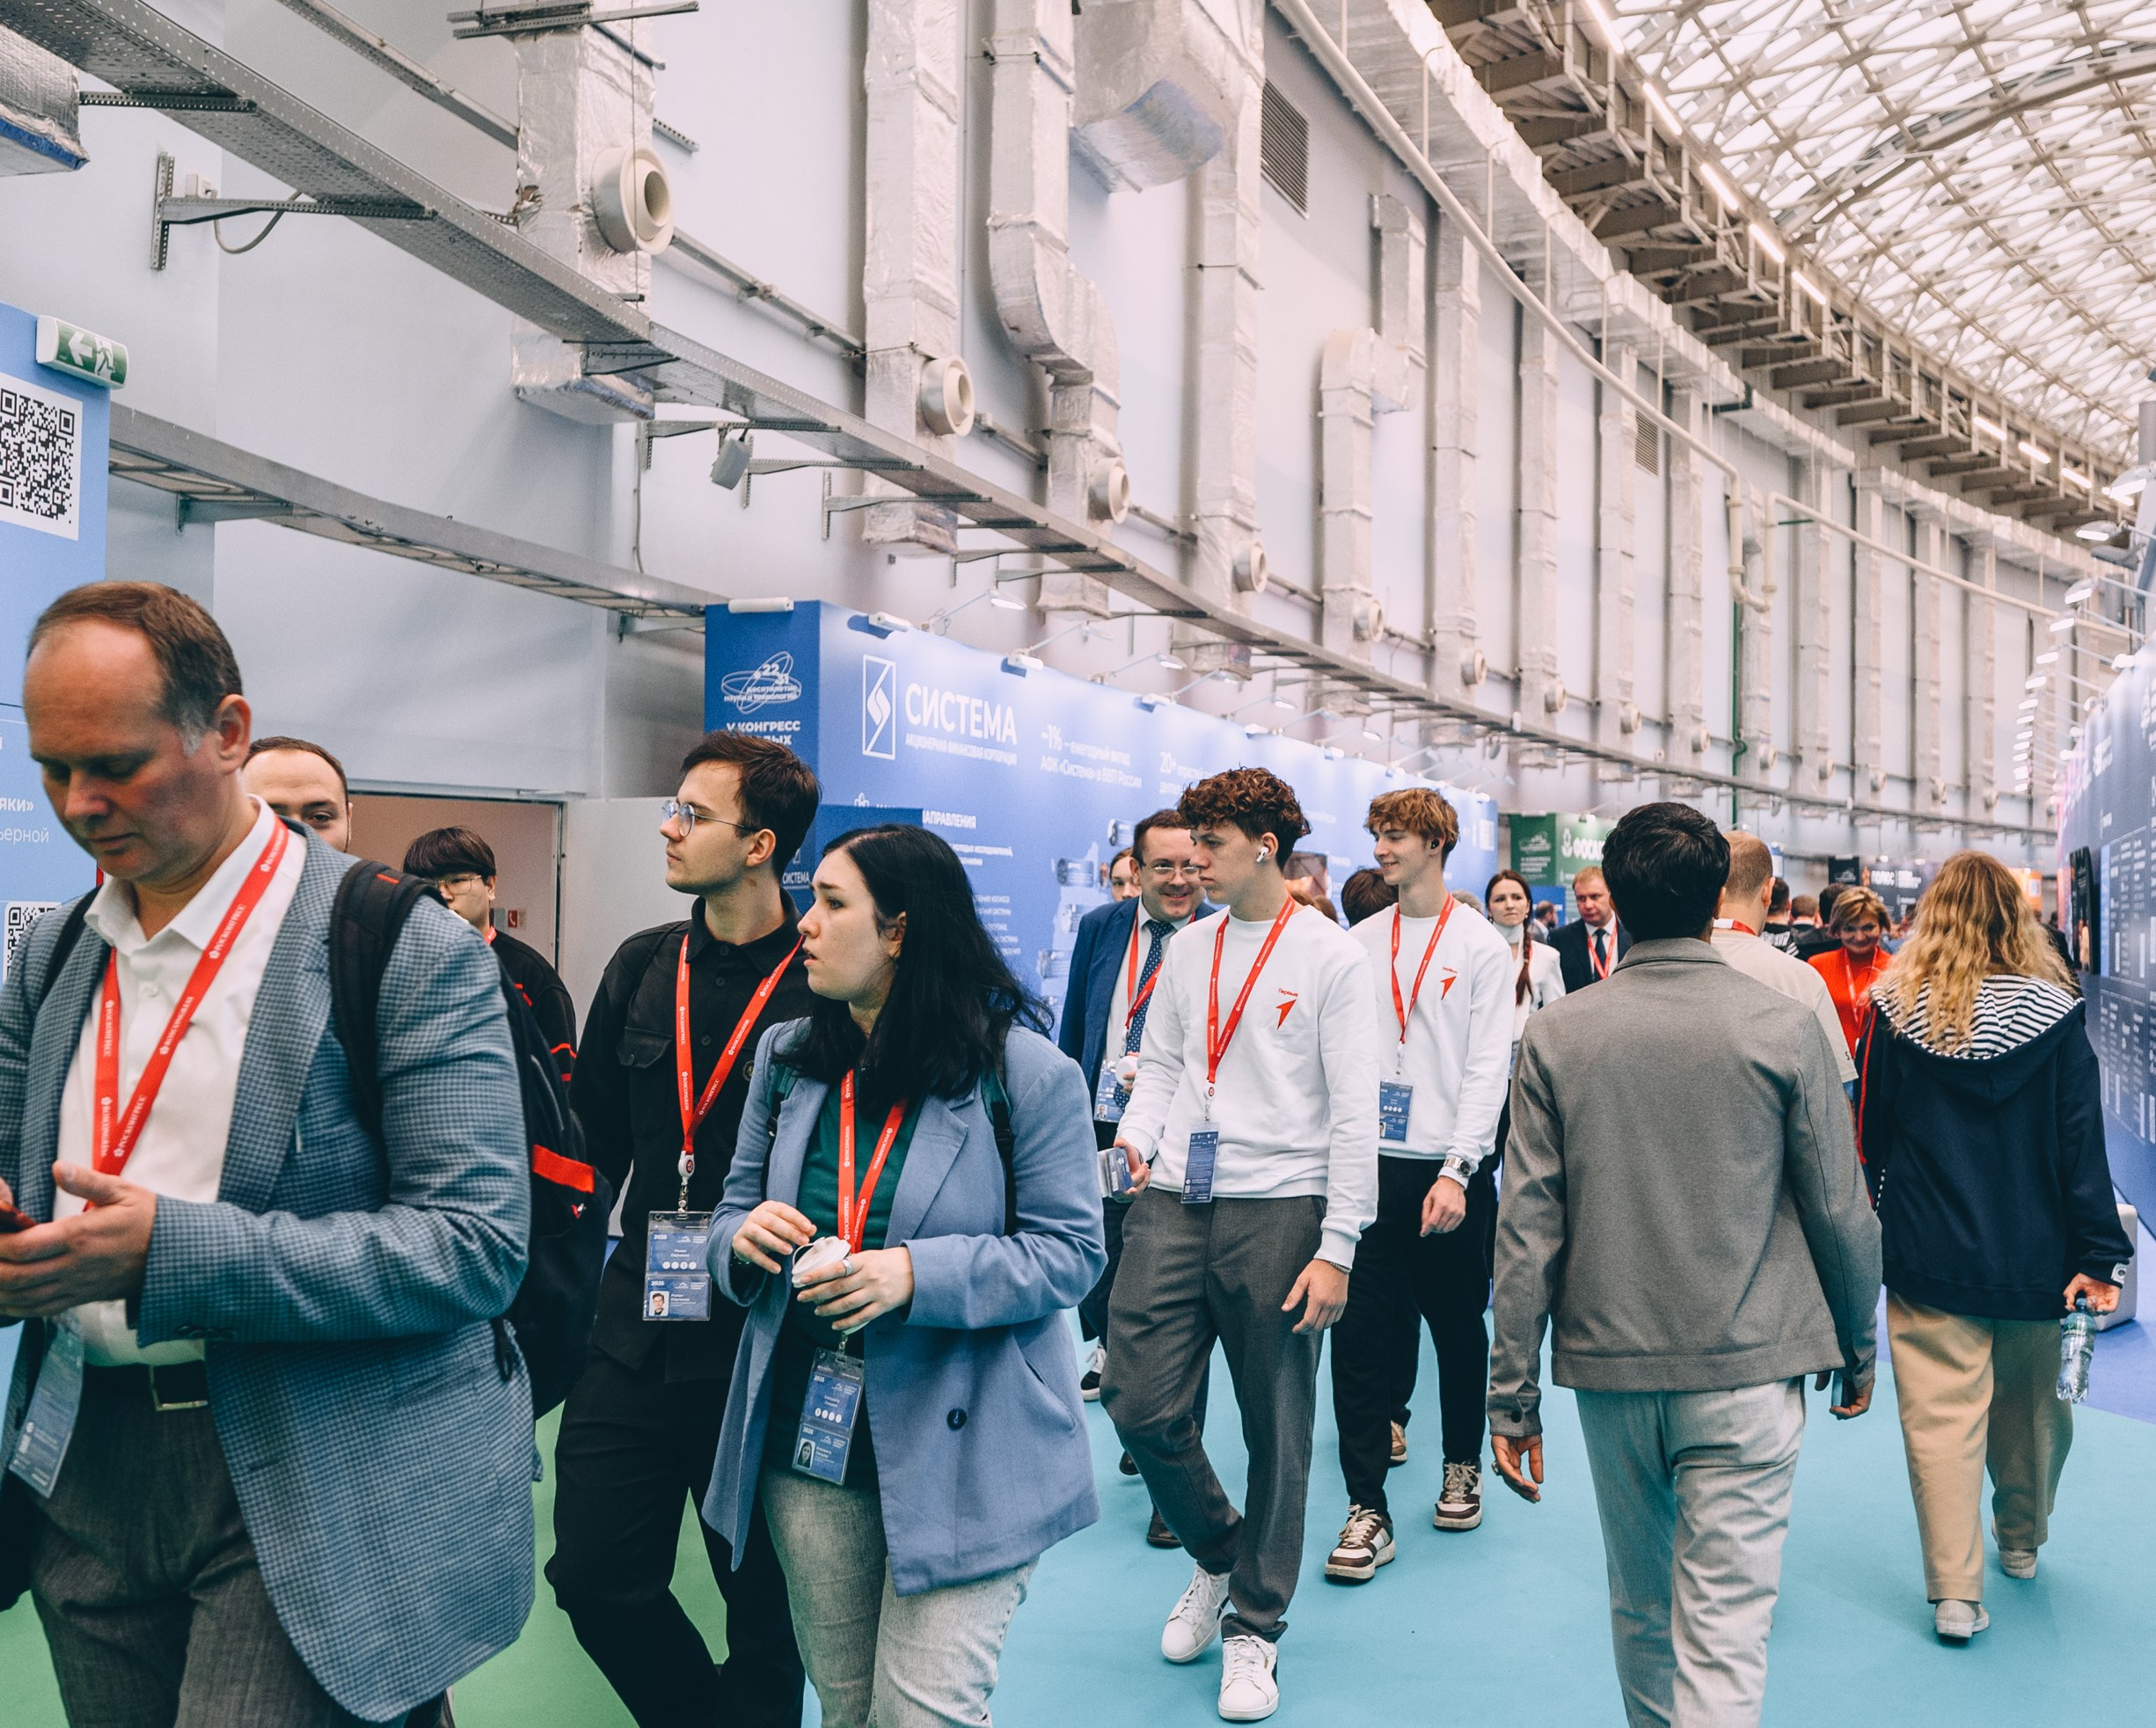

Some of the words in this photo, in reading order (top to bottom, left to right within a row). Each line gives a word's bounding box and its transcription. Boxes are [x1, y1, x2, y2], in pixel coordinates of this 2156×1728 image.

[762, 663, 779, 677] 22
[904, 682, 1018, 746] СИСТЕМА
[737, 721, 801, 732] КОНГРЕСС
[782, 871, 810, 885] СИСТЕМА
